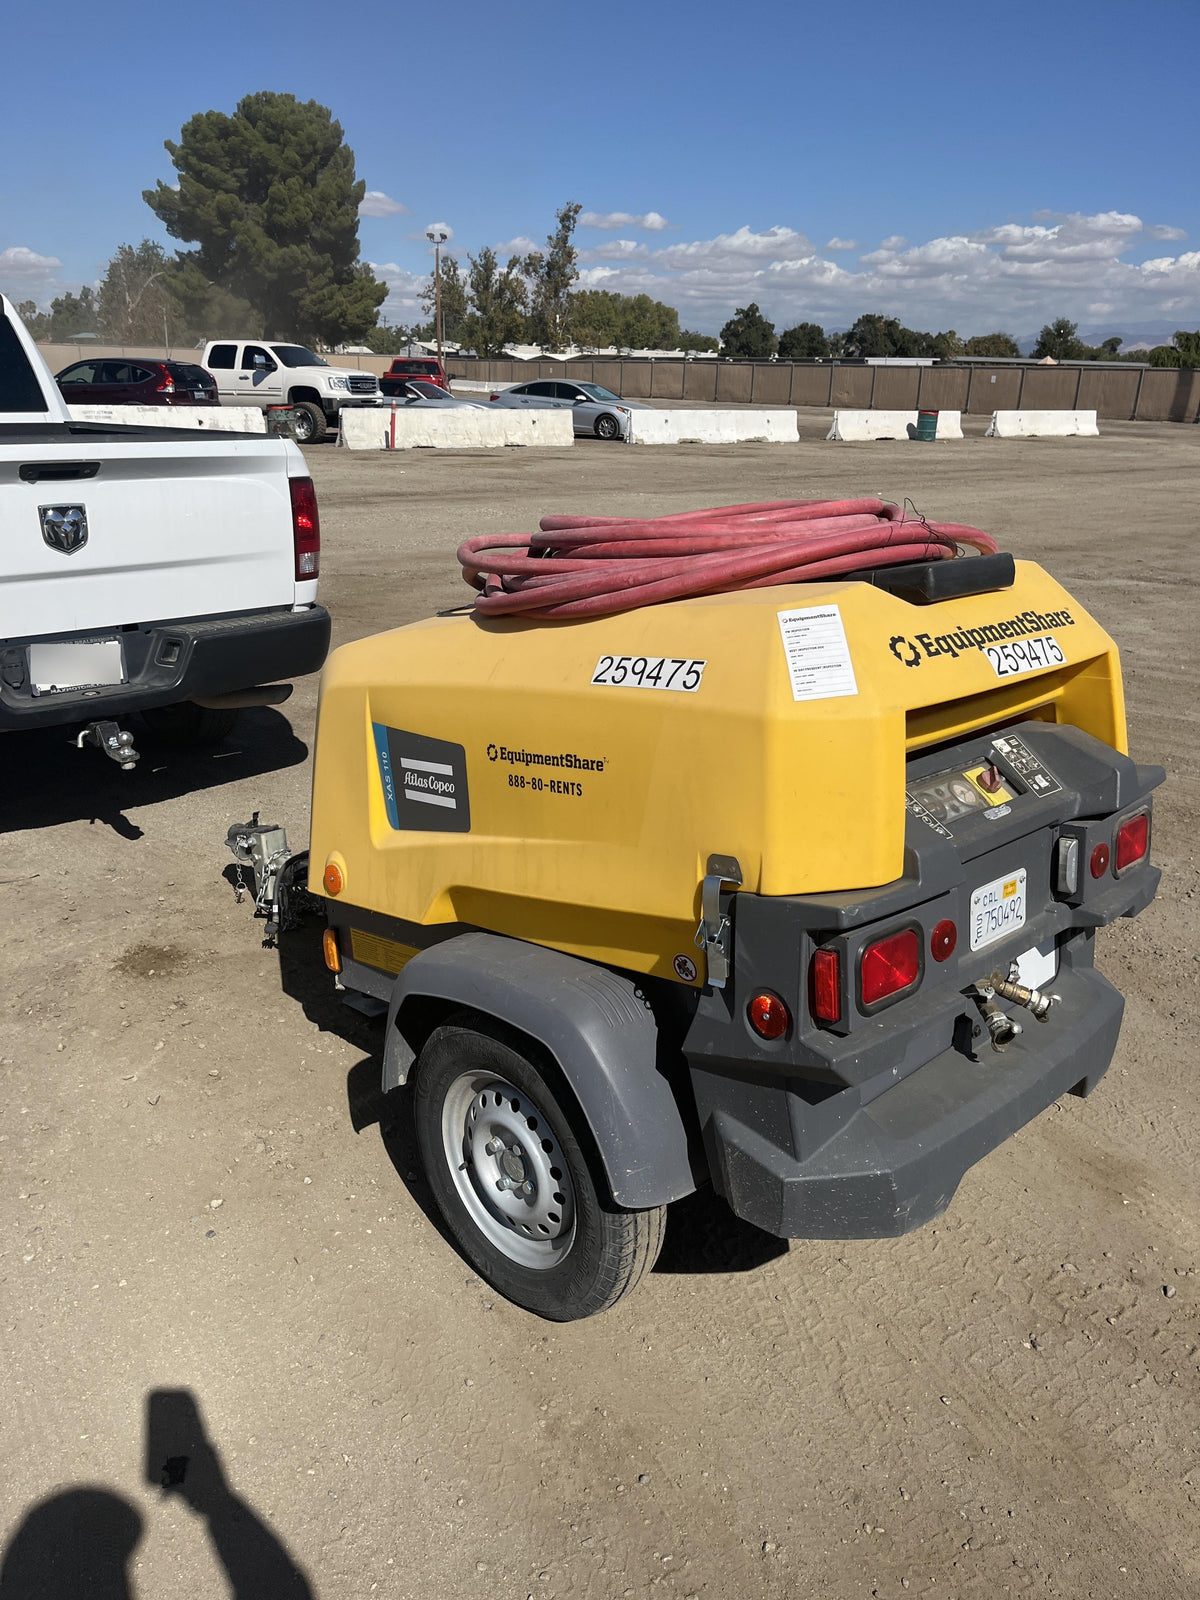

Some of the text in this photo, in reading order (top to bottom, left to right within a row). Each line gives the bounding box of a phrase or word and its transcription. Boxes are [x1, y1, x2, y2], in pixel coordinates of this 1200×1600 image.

[788, 613, 837, 622] EquipmentShare
[914, 610, 1075, 658] EquipmentShare
[987, 637, 1064, 676] 259475
[592, 656, 705, 690] 259475
[500, 746, 604, 772] EquipmentShare
[381, 751, 394, 801] XAS 110
[404, 771, 455, 794] Atlas Copco
[508, 774, 582, 796] 888-80-RENTS
[982, 891, 998, 906] CAL
[984, 896, 1022, 934] 750492
